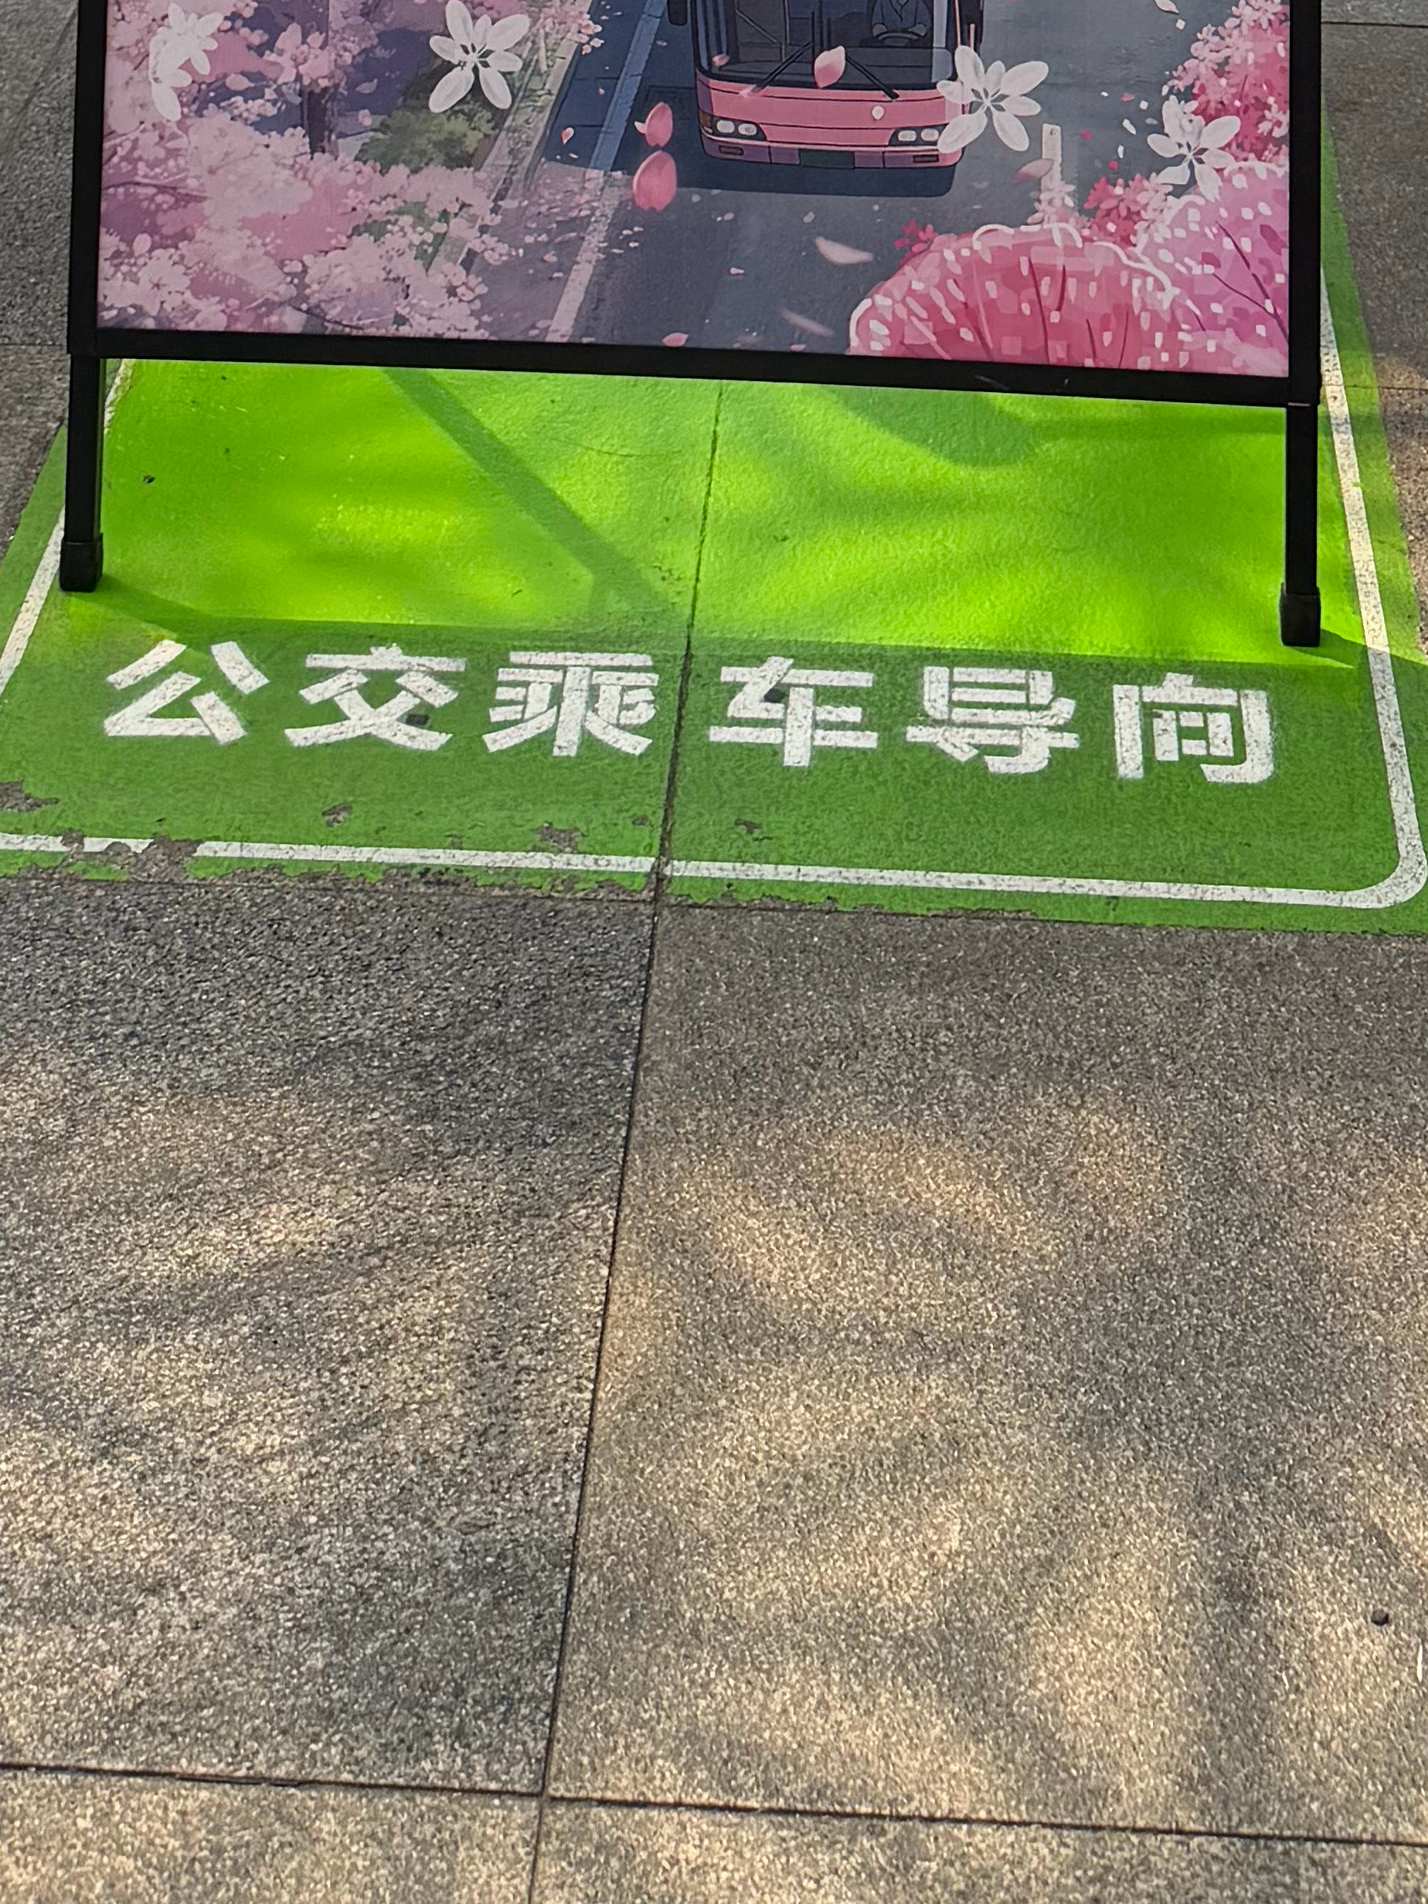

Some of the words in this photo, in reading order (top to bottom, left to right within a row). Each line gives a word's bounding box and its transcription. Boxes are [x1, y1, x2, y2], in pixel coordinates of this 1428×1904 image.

[103, 637, 1275, 785] 公交乘车导向
